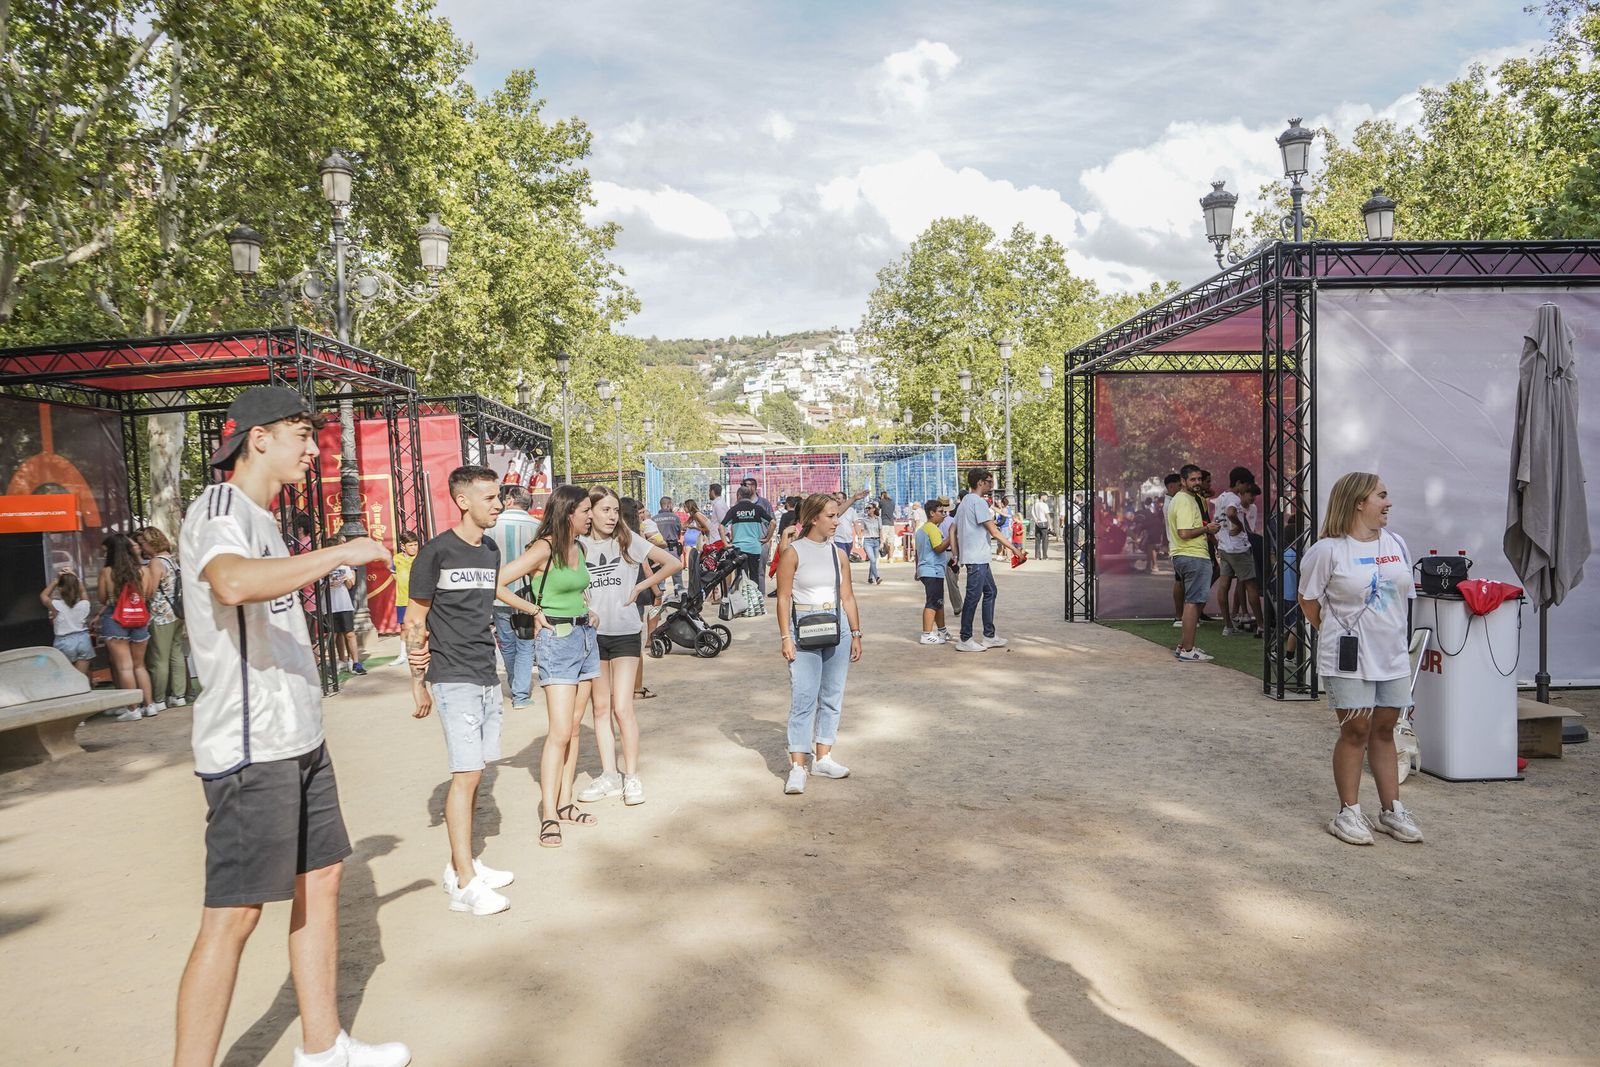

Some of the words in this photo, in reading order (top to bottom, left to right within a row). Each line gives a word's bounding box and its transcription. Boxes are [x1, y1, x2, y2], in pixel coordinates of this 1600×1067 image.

[1375, 555, 1401, 566] SEUR
[450, 571, 482, 583] CALVIN
[483, 571, 495, 582] KLE
